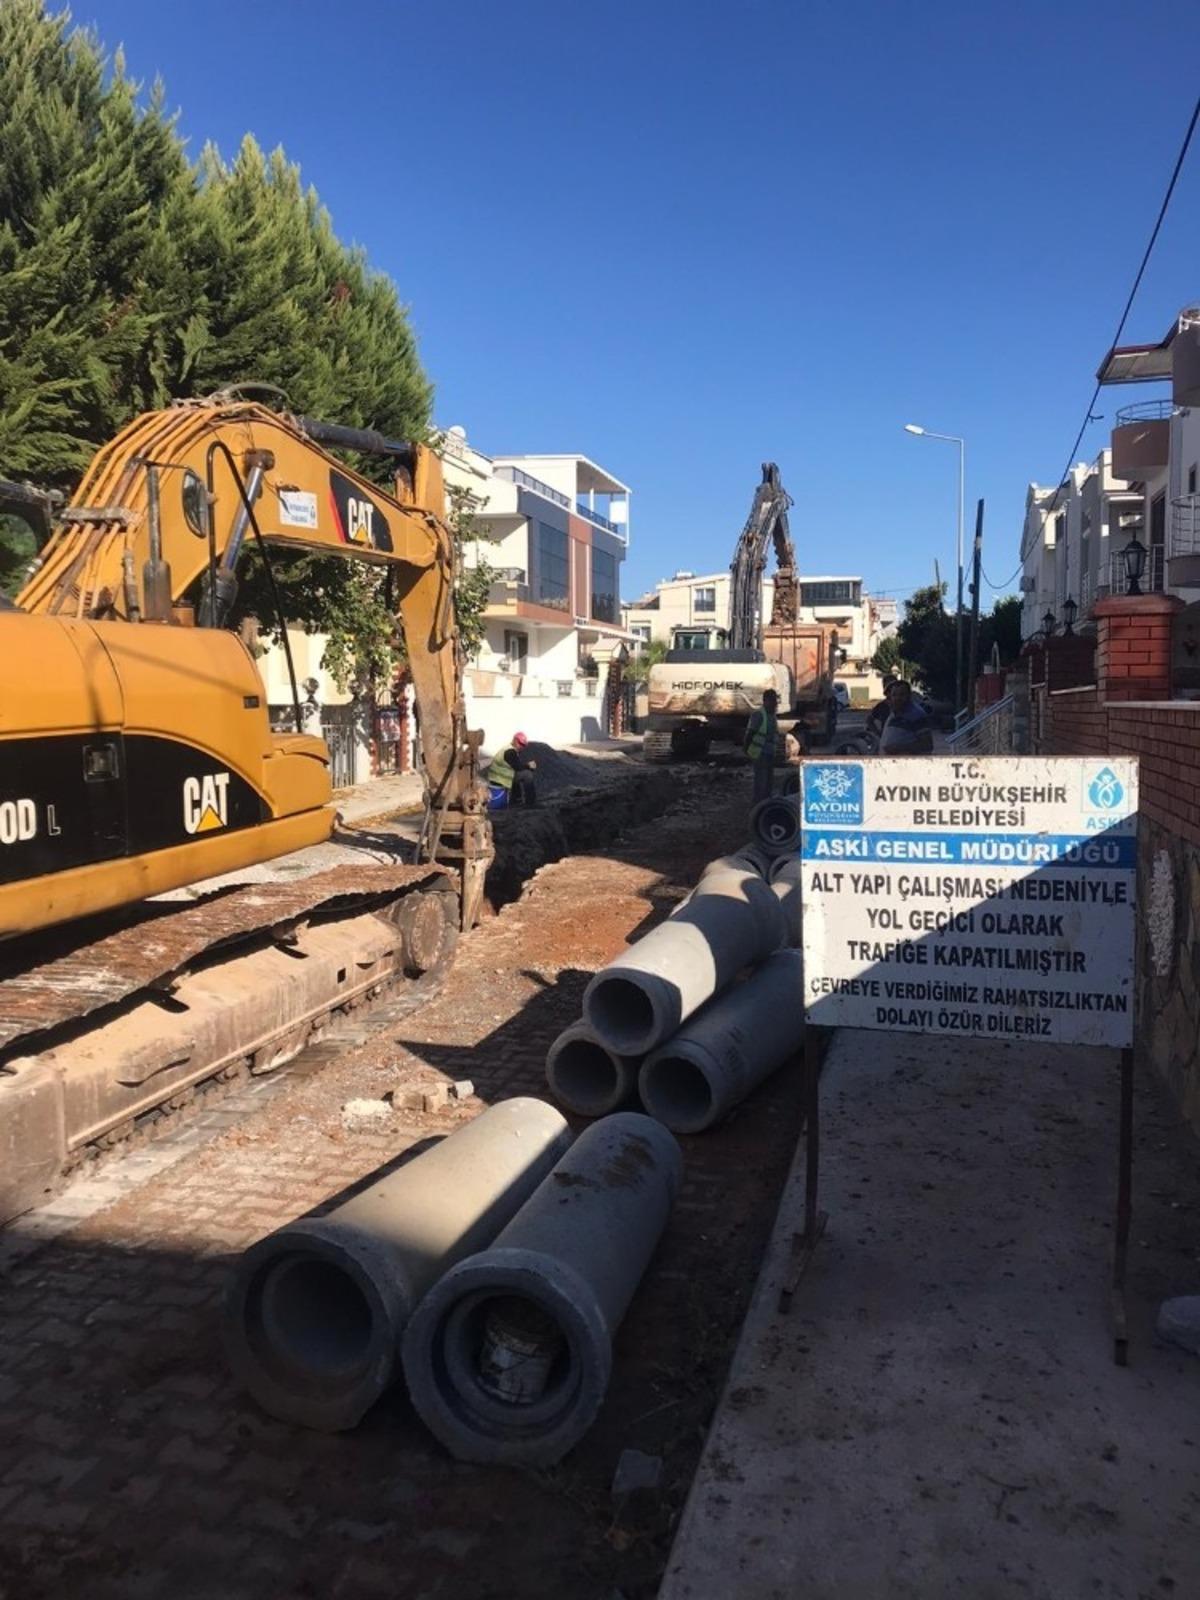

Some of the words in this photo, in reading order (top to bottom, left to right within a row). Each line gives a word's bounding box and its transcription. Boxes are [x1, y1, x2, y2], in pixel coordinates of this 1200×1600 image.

[348, 497, 374, 546] CAT
[951, 762, 986, 779] T.C.
[183, 772, 230, 835] CAT
[808, 802, 860, 813] AYDIN
[874, 785, 931, 802] AYDIN
[937, 783, 1067, 807] BÜYÜKŞEHİR
[47, 804, 61, 836] L
[912, 806, 1026, 827] BELEDİYESİ
[814, 836, 869, 857] ASKİ
[875, 840, 954, 860] GENEL
[960, 840, 1120, 864] MÜDÜRLÜĞÜ
[810, 872, 844, 893] ALT
[850, 874, 891, 895] YAPI
[897, 875, 1003, 903] ÇALIŞMASI
[1010, 875, 1128, 904] NEDENİYLE
[866, 908, 903, 930] YOL
[908, 906, 975, 937] GEÇİCİ
[981, 912, 1064, 936] OLARAK
[847, 938, 928, 965] TRAFİĞE
[933, 945, 1087, 977] KAPATILMIŞTIR
[810, 977, 880, 998] ÇEVREYE
[884, 979, 979, 1004] VERDİĞİMİZ
[983, 986, 1128, 1013] RAHATSIZLIKTAN
[876, 1007, 933, 1028] DOLAYI
[938, 1007, 983, 1031] ÖZÜR
[987, 1011, 1053, 1036] DİLERİZ
